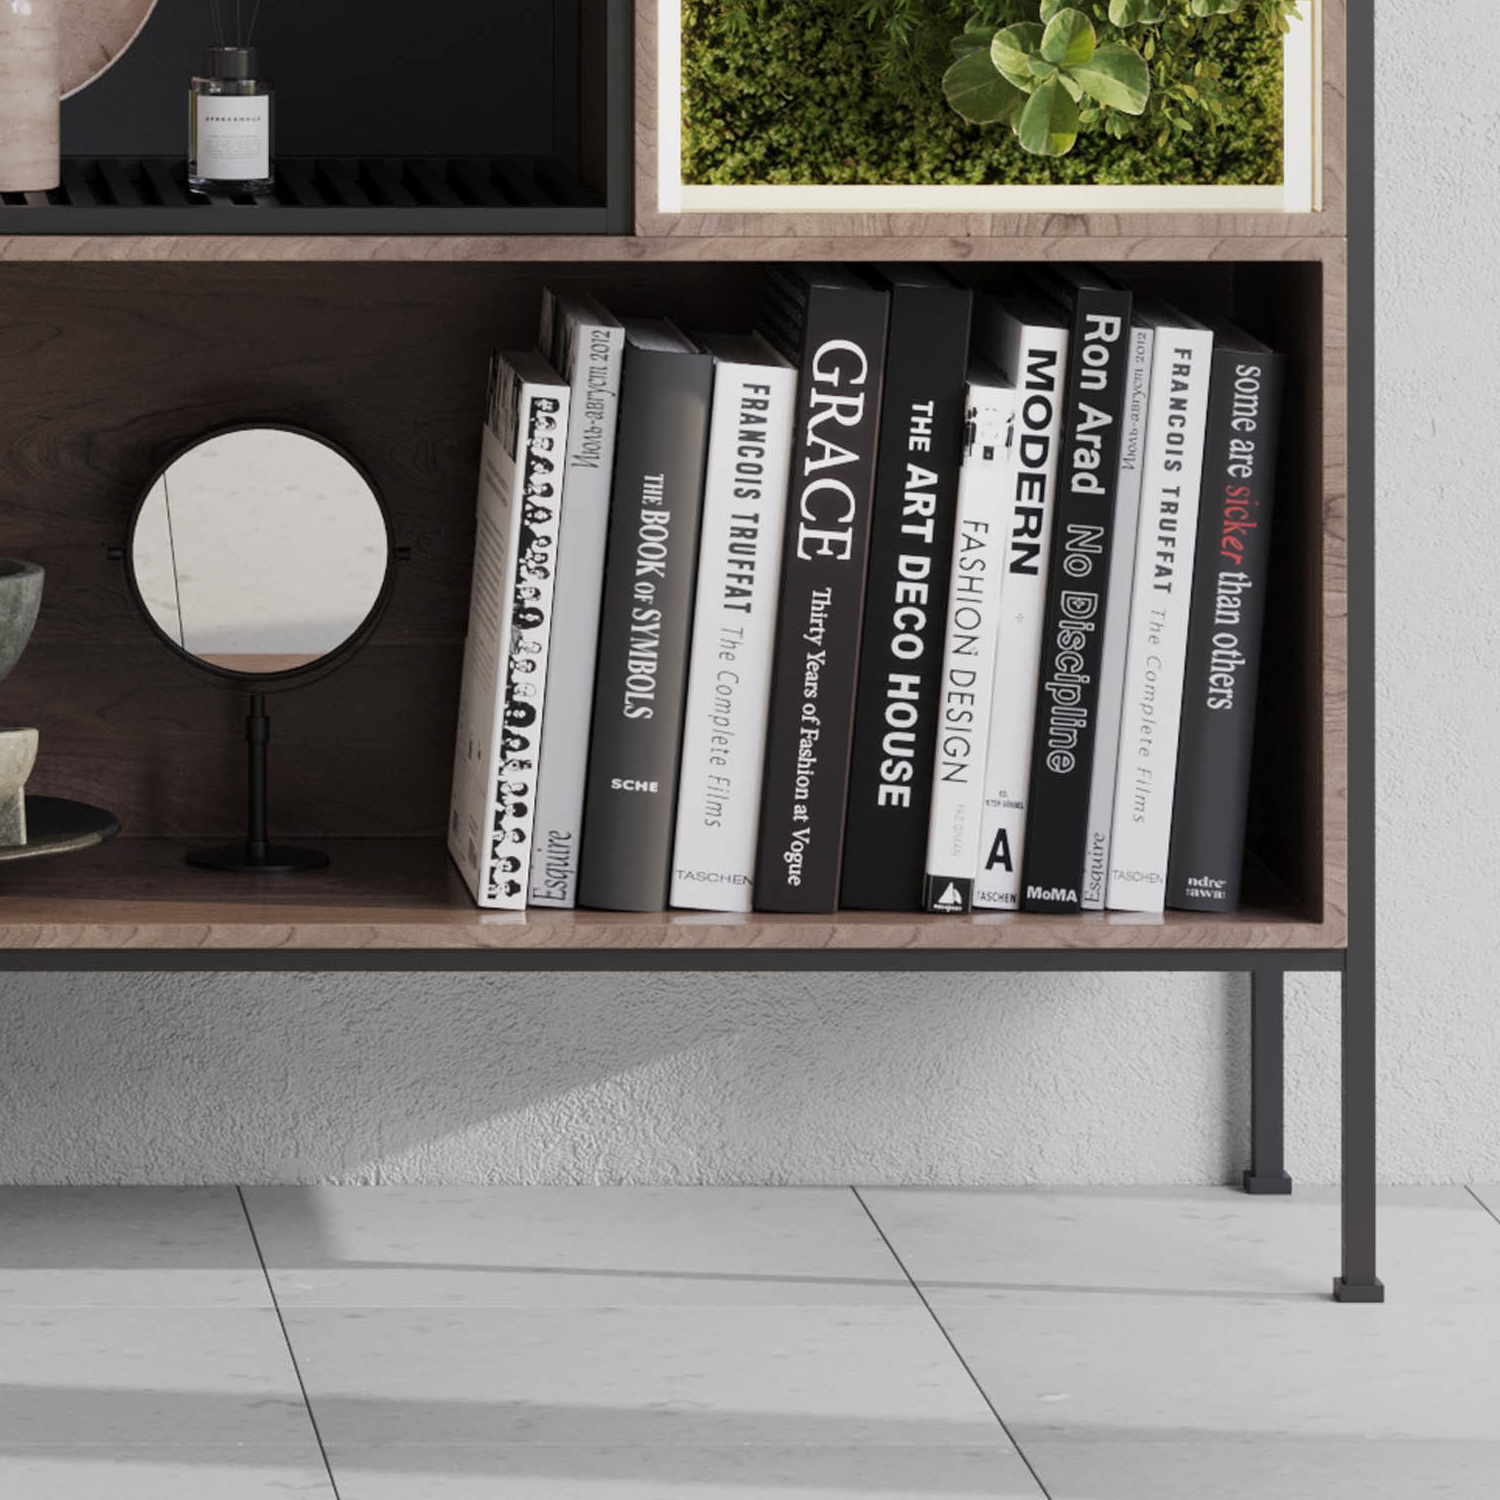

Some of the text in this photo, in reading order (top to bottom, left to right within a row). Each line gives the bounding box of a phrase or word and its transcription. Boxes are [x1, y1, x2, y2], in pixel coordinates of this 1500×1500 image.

[572, 329, 616, 469] Июль-август 2012
[797, 339, 869, 561] GRACE
[1135, 331, 1147, 363] 2012
[1009, 348, 1058, 576] MODERN
[1045, 313, 1121, 774] Ron Arad No Discipline
[1207, 364, 1261, 710] some are sicker than others
[623, 473, 670, 720] THE BOOK OF SYMBOLS
[705, 383, 770, 828] FRANCOIS TRUFFAT The Complete Films
[877, 400, 938, 808] THE ART DECO HOUSE
[941, 519, 988, 784] FASHION DESIGN
[1133, 347, 1192, 823] FRANCOIS TRUFFAT The Complete Films
[611, 778, 659, 793] SCHE
[783, 587, 833, 887] Thirty Years of Fashion at Vogue
[533, 830, 572, 901] Esquire
[676, 869, 753, 886] TASCHEN
[985, 827, 1014, 872] A
[1026, 885, 1078, 903] MoMA
[1084, 832, 1106, 903] Esquire
[1111, 869, 1164, 884] TASCHEN
